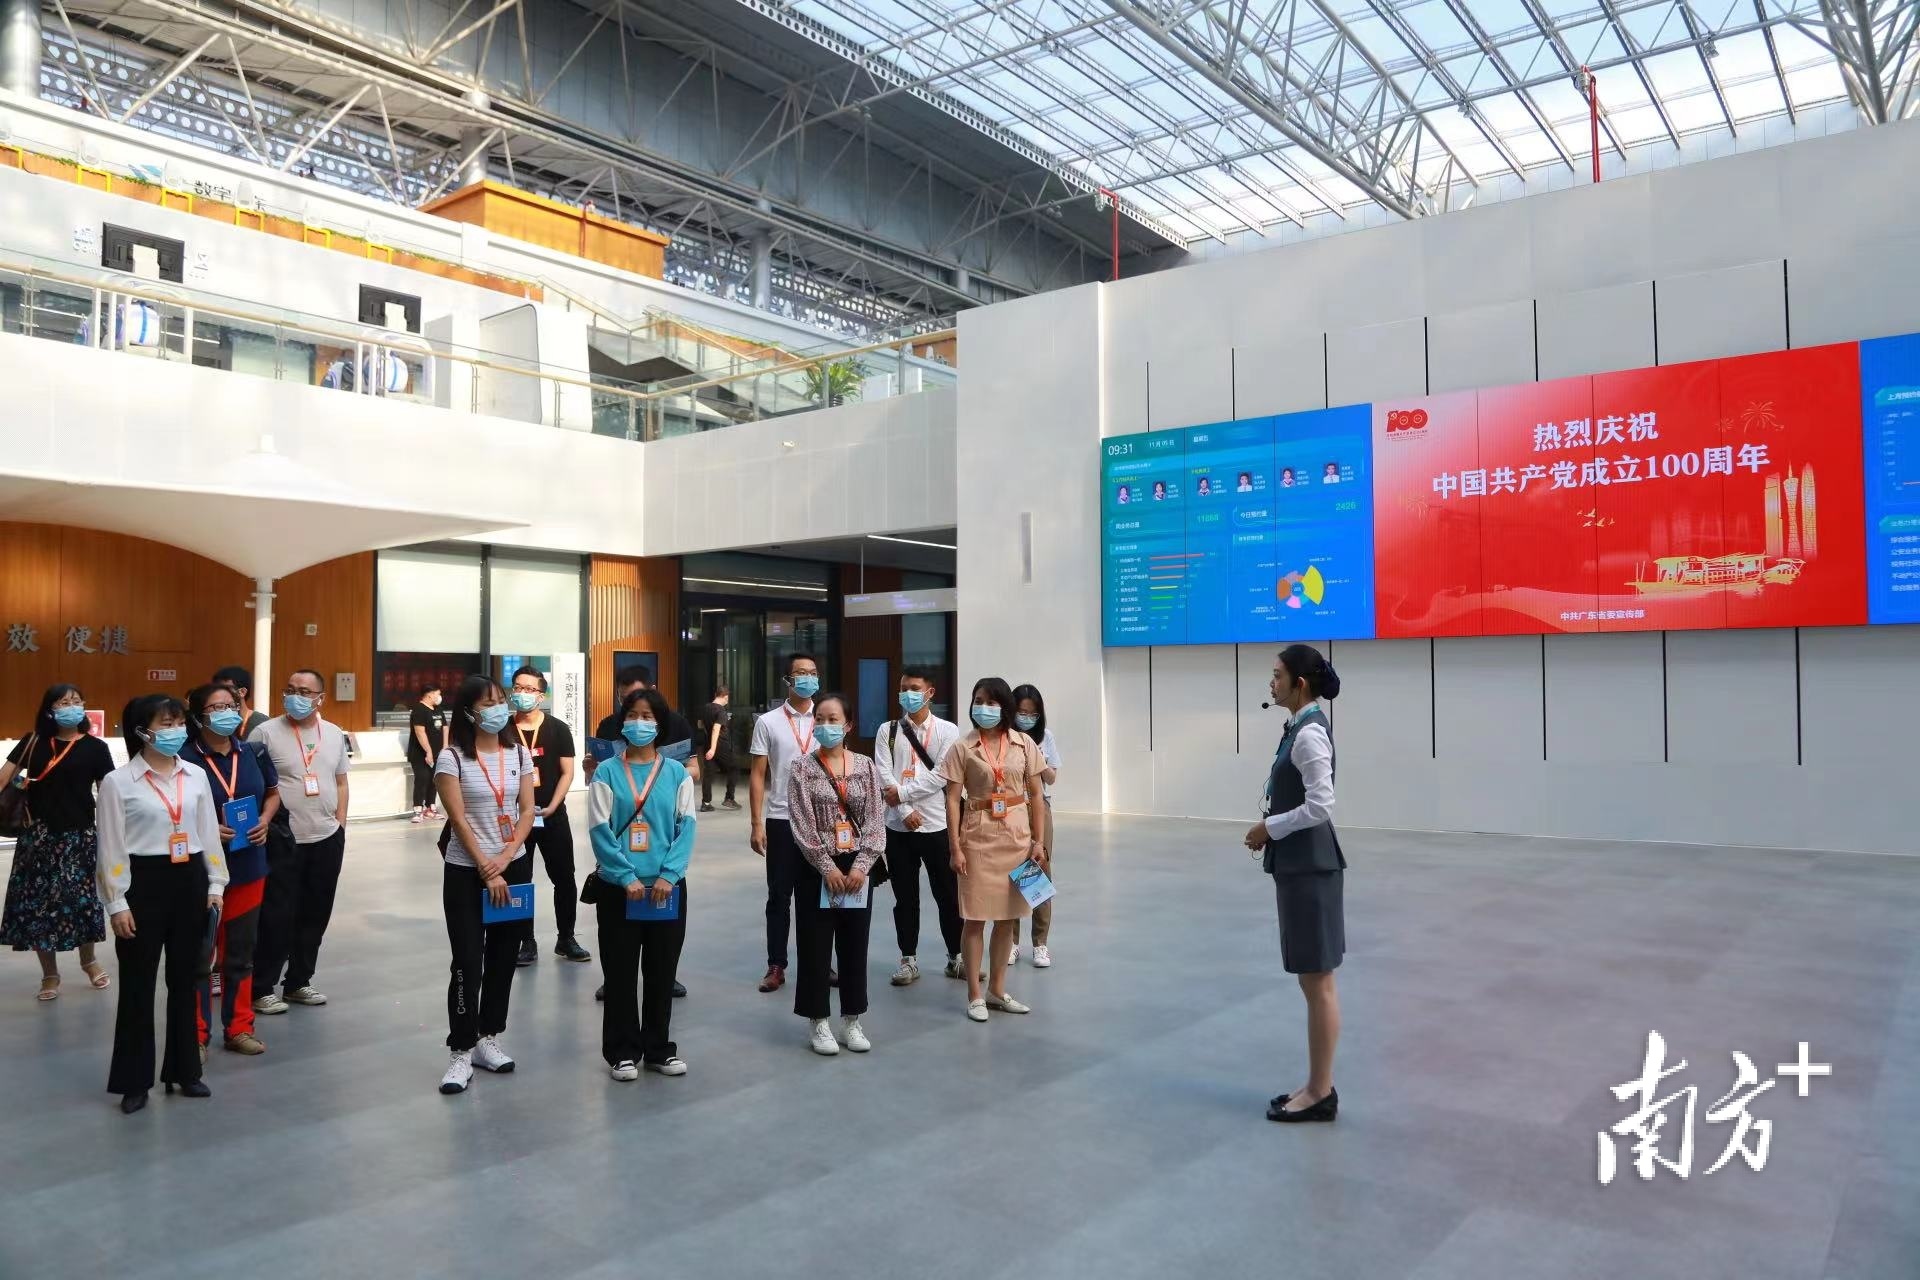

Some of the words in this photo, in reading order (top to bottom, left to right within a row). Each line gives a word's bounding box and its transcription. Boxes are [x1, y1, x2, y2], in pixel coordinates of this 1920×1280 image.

[1533, 412, 1659, 452] 热烈庆祝
[1108, 443, 1133, 456] 09:31
[1432, 443, 1771, 500] 中国共产党成立100周年
[1560, 609, 1646, 621] 中共广东省委宣传部
[7, 624, 40, 652] 效
[65, 624, 129, 655] 便捷
